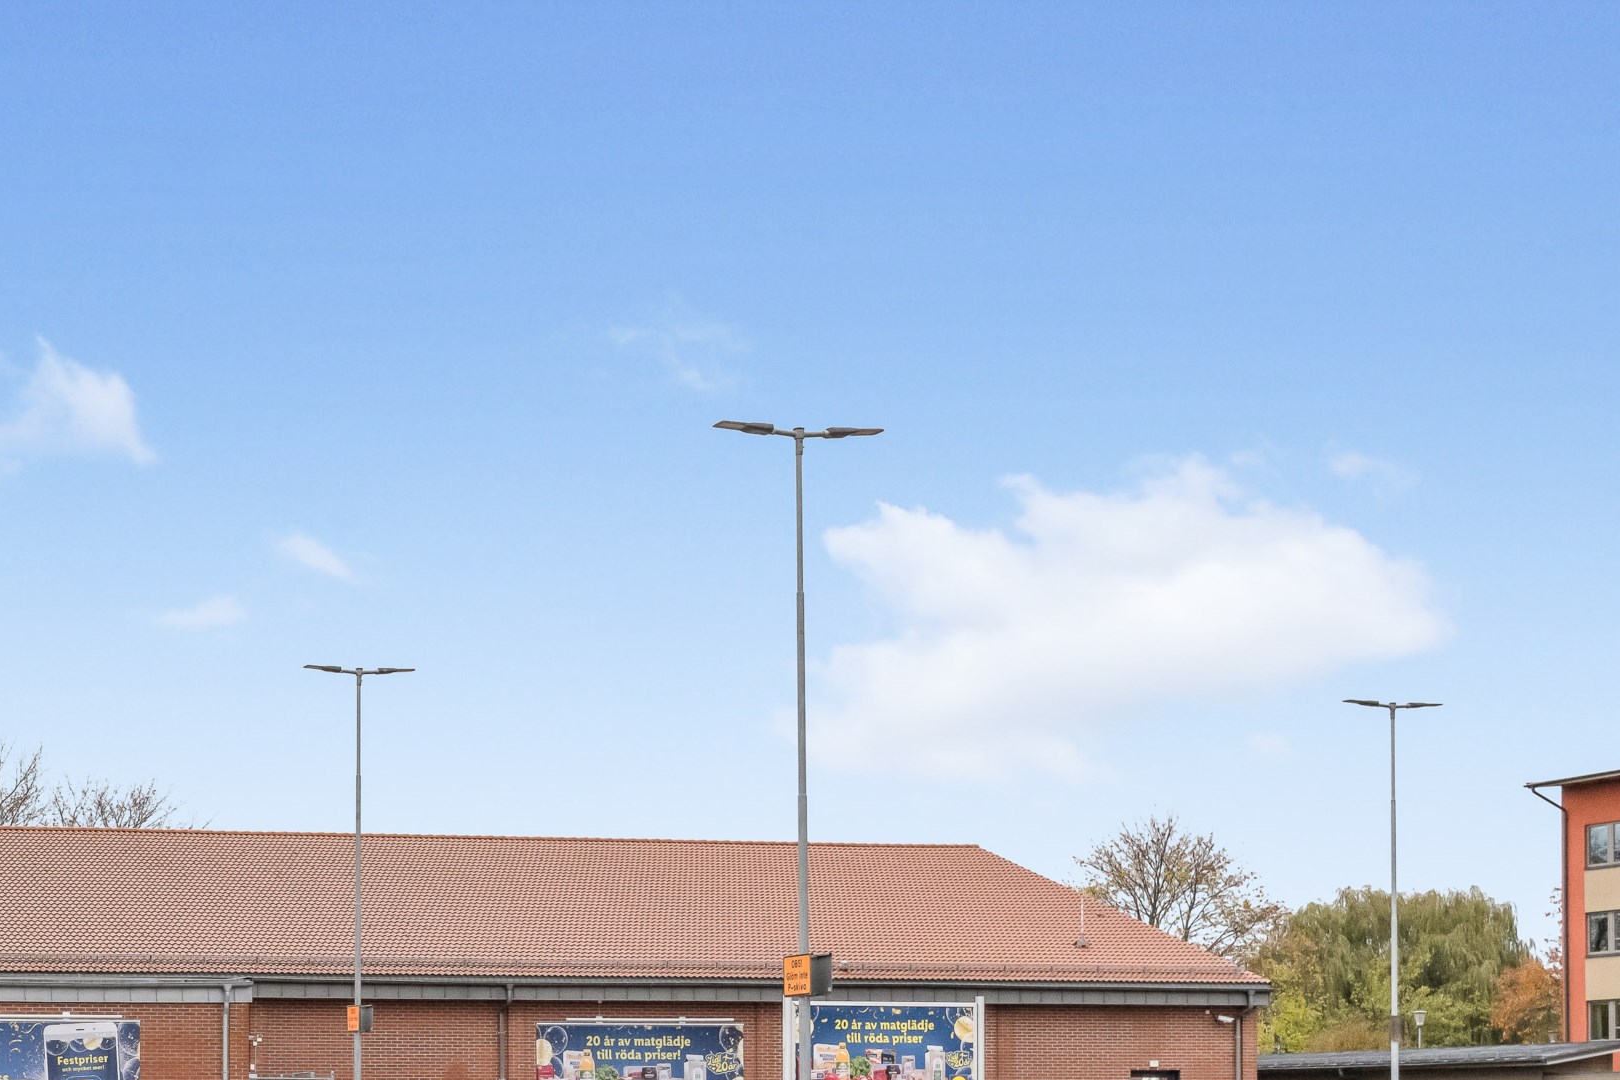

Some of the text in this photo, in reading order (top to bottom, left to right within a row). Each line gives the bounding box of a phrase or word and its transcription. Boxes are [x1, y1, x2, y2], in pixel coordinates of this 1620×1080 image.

[791, 959, 802, 968] OBS!
[799, 971, 808, 979] inte
[788, 983, 806, 991] P-skiva
[835, 1018, 935, 1033] 20 år av matglädje
[586, 1034, 691, 1049] 20 år av matglädje
[846, 1032, 923, 1045] till röda priser
[57, 1054, 109, 1067] Festpriser
[597, 1049, 682, 1062] till röda priser!
